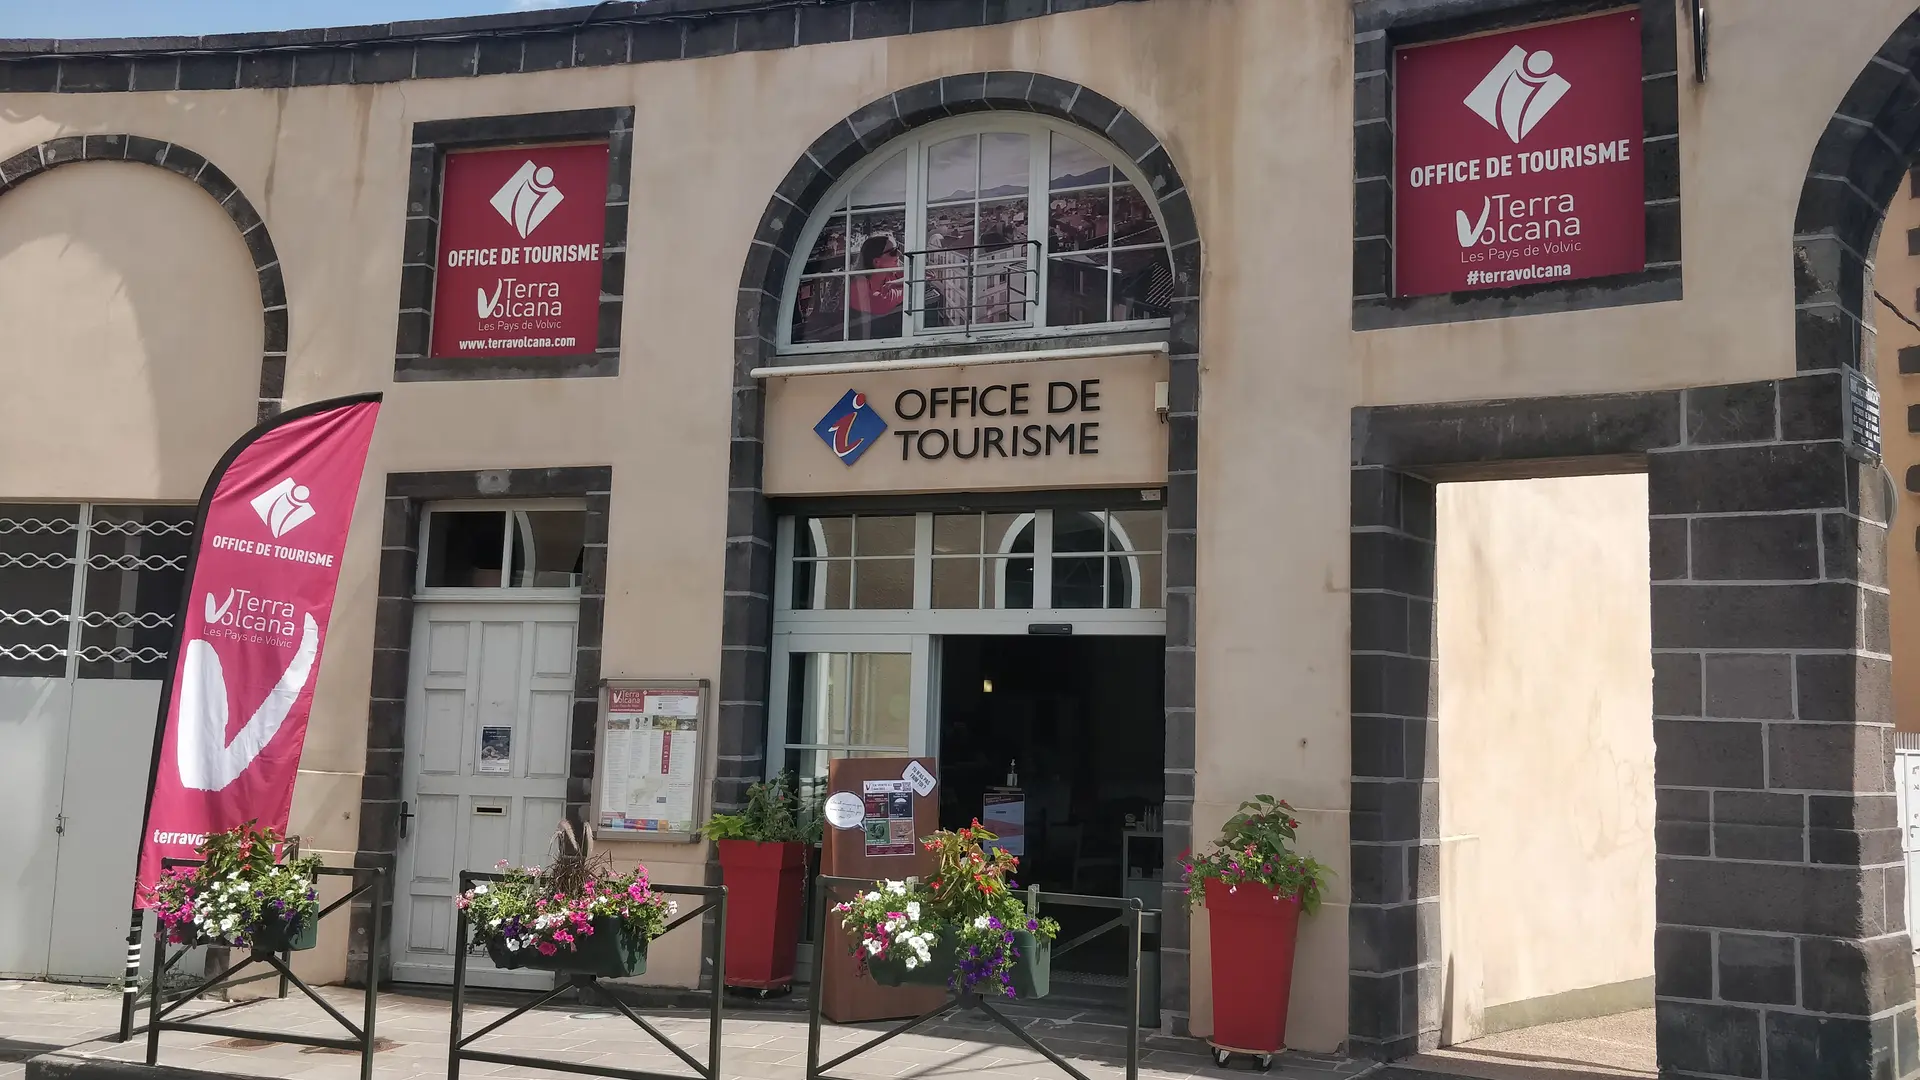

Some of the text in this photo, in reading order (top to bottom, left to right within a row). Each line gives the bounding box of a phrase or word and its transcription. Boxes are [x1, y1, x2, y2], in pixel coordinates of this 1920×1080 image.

[1410, 139, 1630, 188] OFFICE DE TOURISME
[1492, 193, 1574, 220] Terra
[1456, 196, 1581, 248] Volcana
[448, 244, 600, 268] OFFICE DE TOURISME
[1461, 241, 1582, 263] Les Pays de Volvic
[503, 278, 560, 299] Terra
[1466, 264, 1571, 285] #terravolcana
[477, 278, 562, 319] Volcana
[478, 319, 562, 332] Les Pays de Volvic
[459, 336, 576, 350] www.terravolcana.com
[894, 379, 1100, 421] OFFICE DE
[893, 422, 1100, 461] TOURISME
[212, 535, 334, 568] OFFICE DE TOURISME
[205, 587, 295, 637] Volcana
[236, 589, 295, 618] Terra
[203, 625, 292, 649] Les Pays de Volvic
